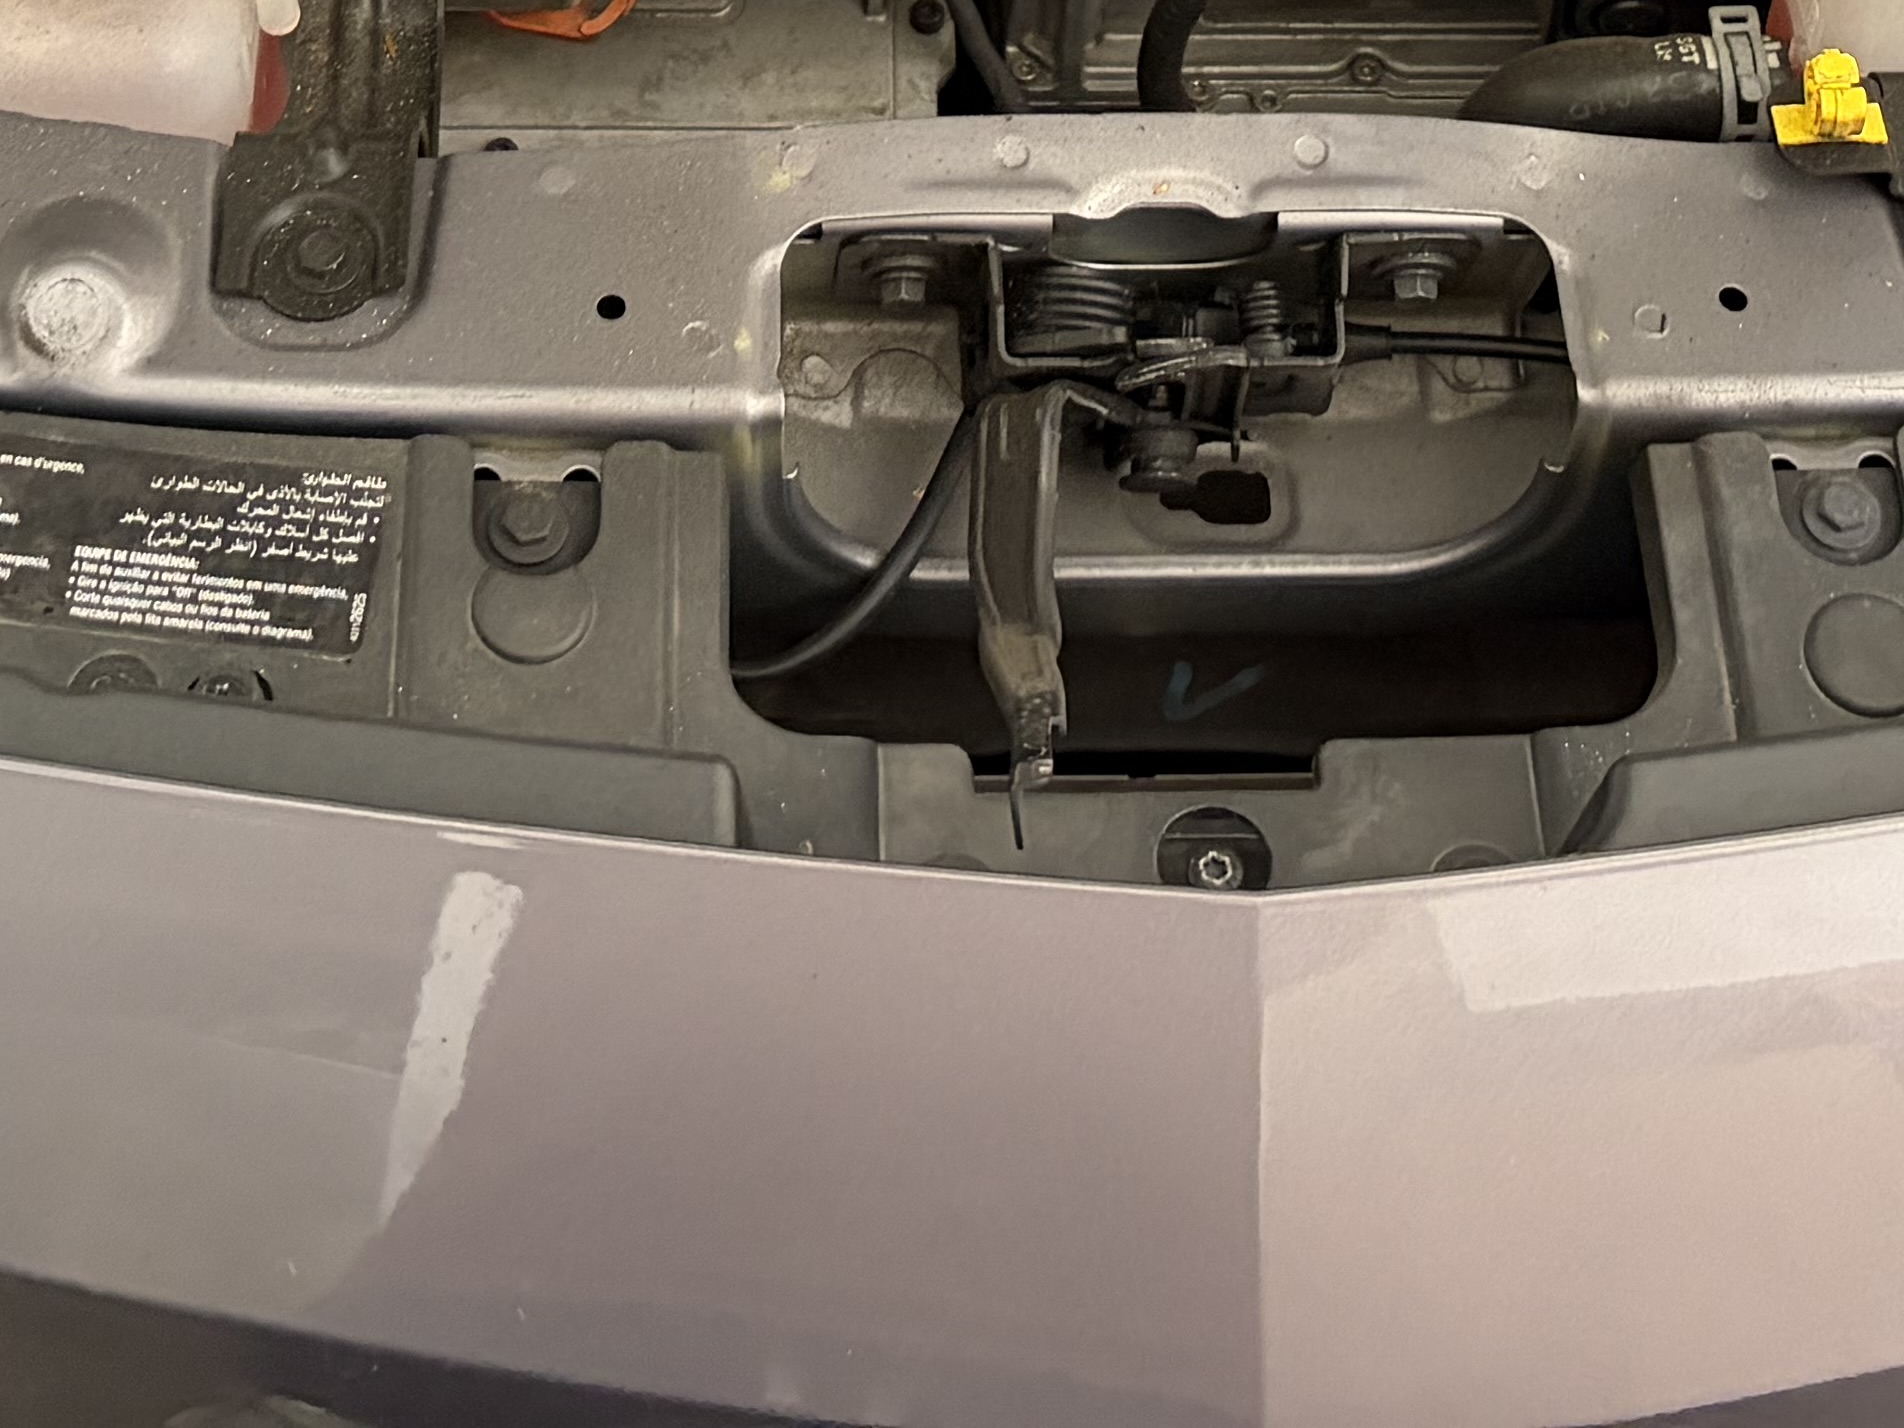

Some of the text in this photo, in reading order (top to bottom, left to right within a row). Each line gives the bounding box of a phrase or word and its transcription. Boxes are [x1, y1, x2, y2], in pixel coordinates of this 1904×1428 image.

[0, 453, 12, 464] en
[14, 454, 33, 467] cas
[73, 544, 200, 570] EQUIPE DE EMERGÊNCIA:
[77, 575, 97, 589] Gire
[99, 580, 107, 590] a
[146, 581, 169, 597] para
[69, 605, 119, 622] marcados
[120, 609, 143, 625] pela
[144, 610, 161, 627] fita
[162, 613, 204, 631] amarela
